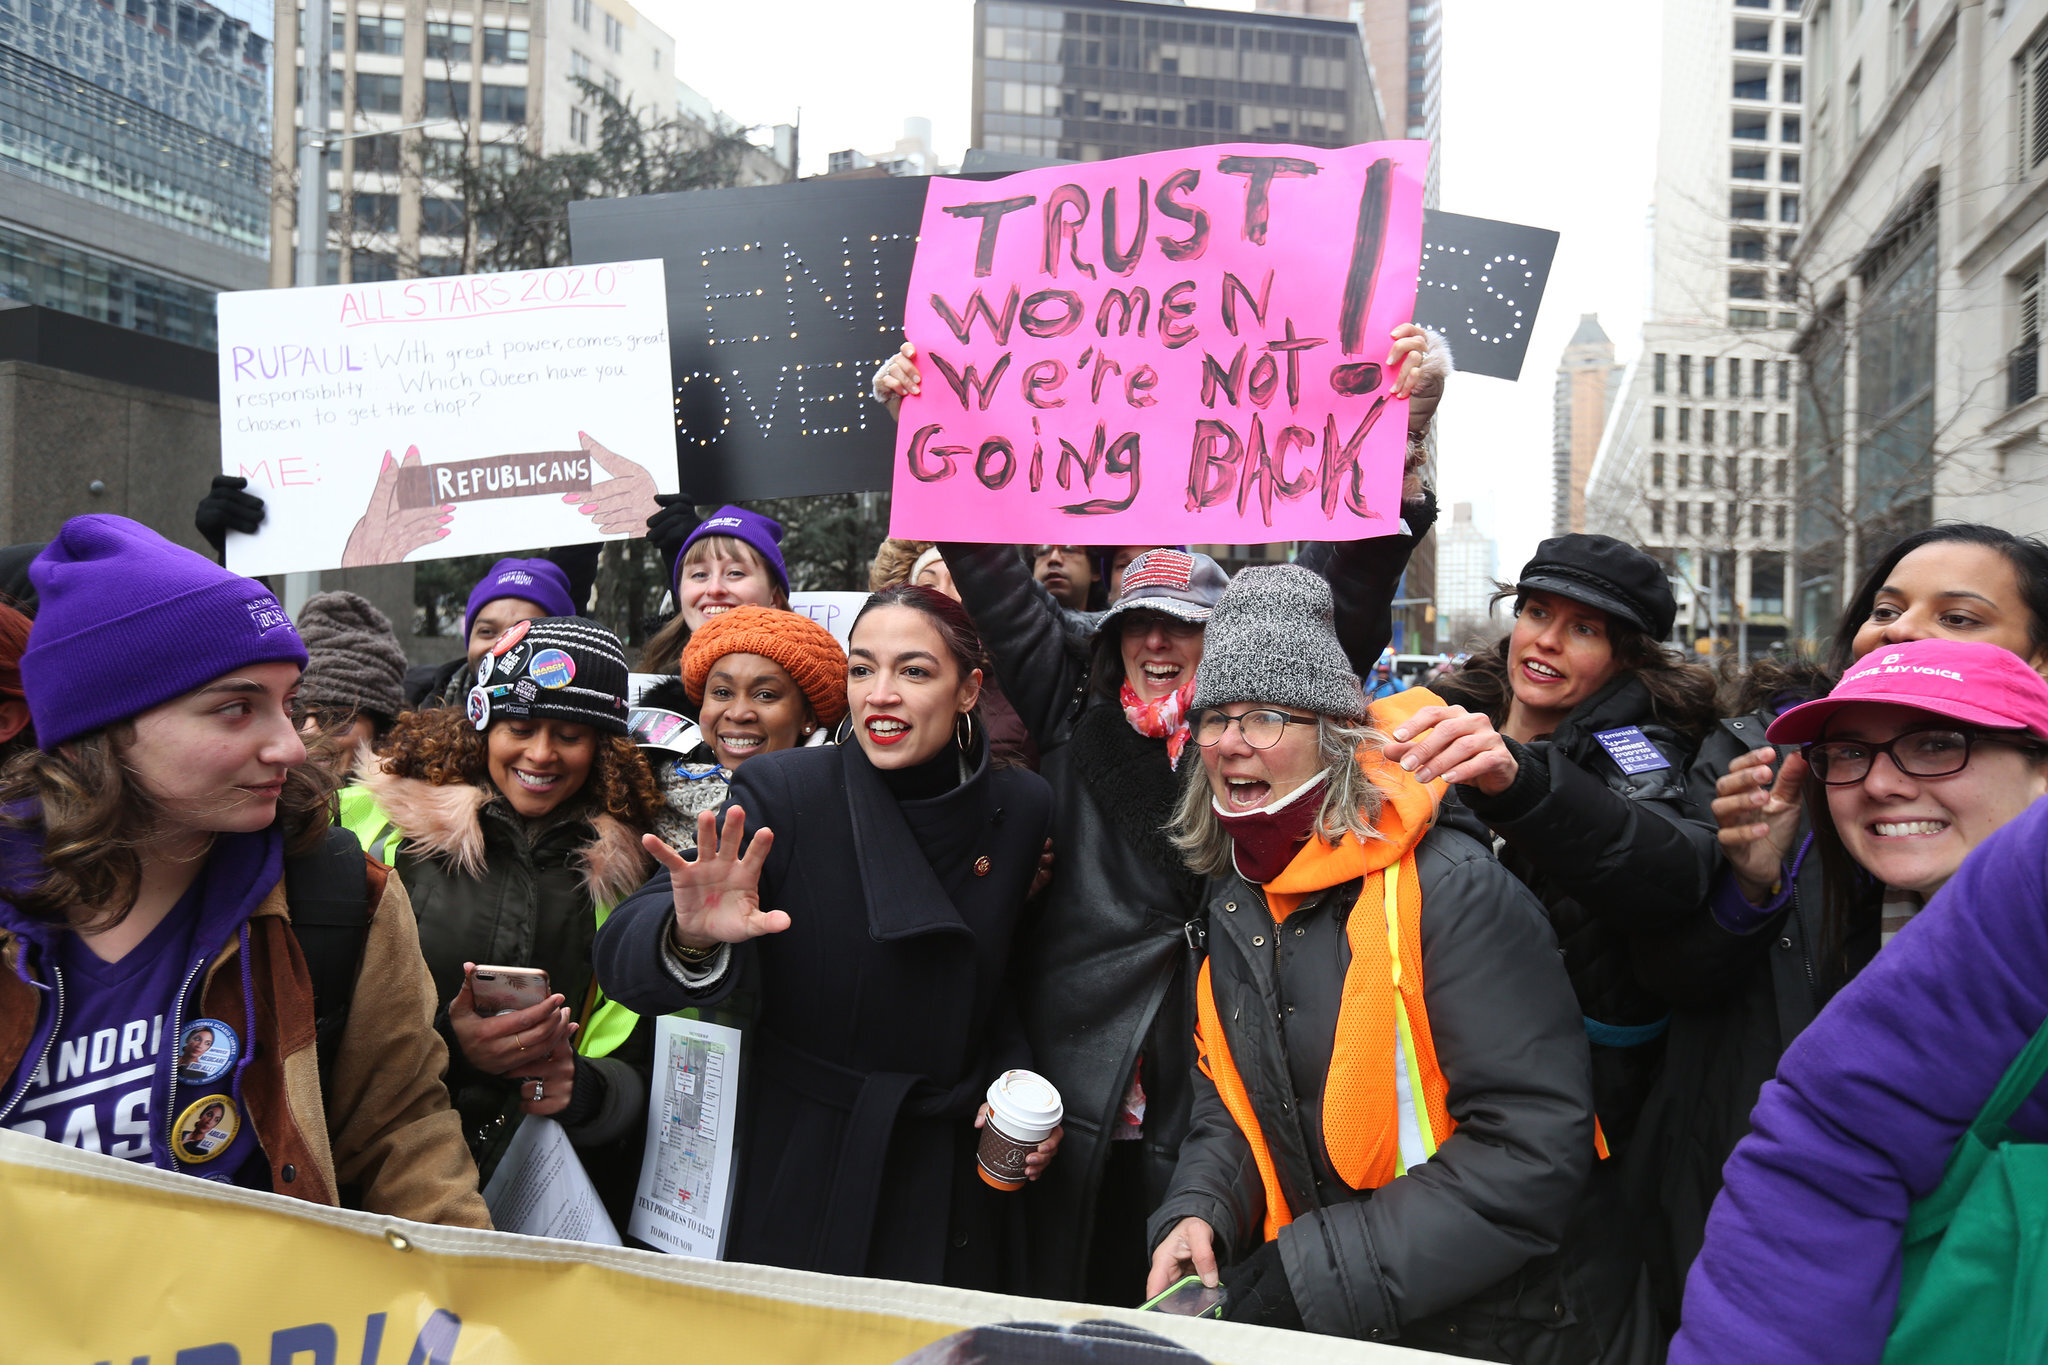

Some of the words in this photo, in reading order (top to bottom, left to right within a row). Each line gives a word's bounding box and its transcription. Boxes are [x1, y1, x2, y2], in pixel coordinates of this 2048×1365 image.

[942, 154, 1324, 281] TRUST
[340, 287, 396, 323] ALL
[404, 277, 512, 318] STARS
[520, 266, 616, 303] 2020
[374, 339, 435, 369] With
[446, 340, 495, 372] great
[503, 337, 563, 360] power,
[567, 335, 623, 350] comes
[627, 328, 667, 351] great
[398, 370, 473, 394] Which
[480, 367, 539, 388] Queen
[546, 364, 589, 380] have
[596, 364, 628, 383] you
[314, 407, 337, 426] to
[348, 403, 381, 426] get
[387, 401, 417, 417] the
[424, 391, 482, 417] chop?
[1184, 394, 1392, 528] BACK
[435, 458, 590, 500] REPUBLICANS
[1884, 665, 1911, 674] MY
[1912, 666, 1964, 682] VOICE.
[1597, 729, 1639, 740] Feminista
[1608, 741, 1647, 754] FEMINIST
[638, 1196, 654, 1212] TEXT
[653, 1203, 687, 1226] PROGRESS
[687, 1217, 697, 1231] TO
[650, 1225, 658, 1236] TO
[657, 1228, 680, 1246] DONATE
[680, 1239, 693, 1252] NOW
